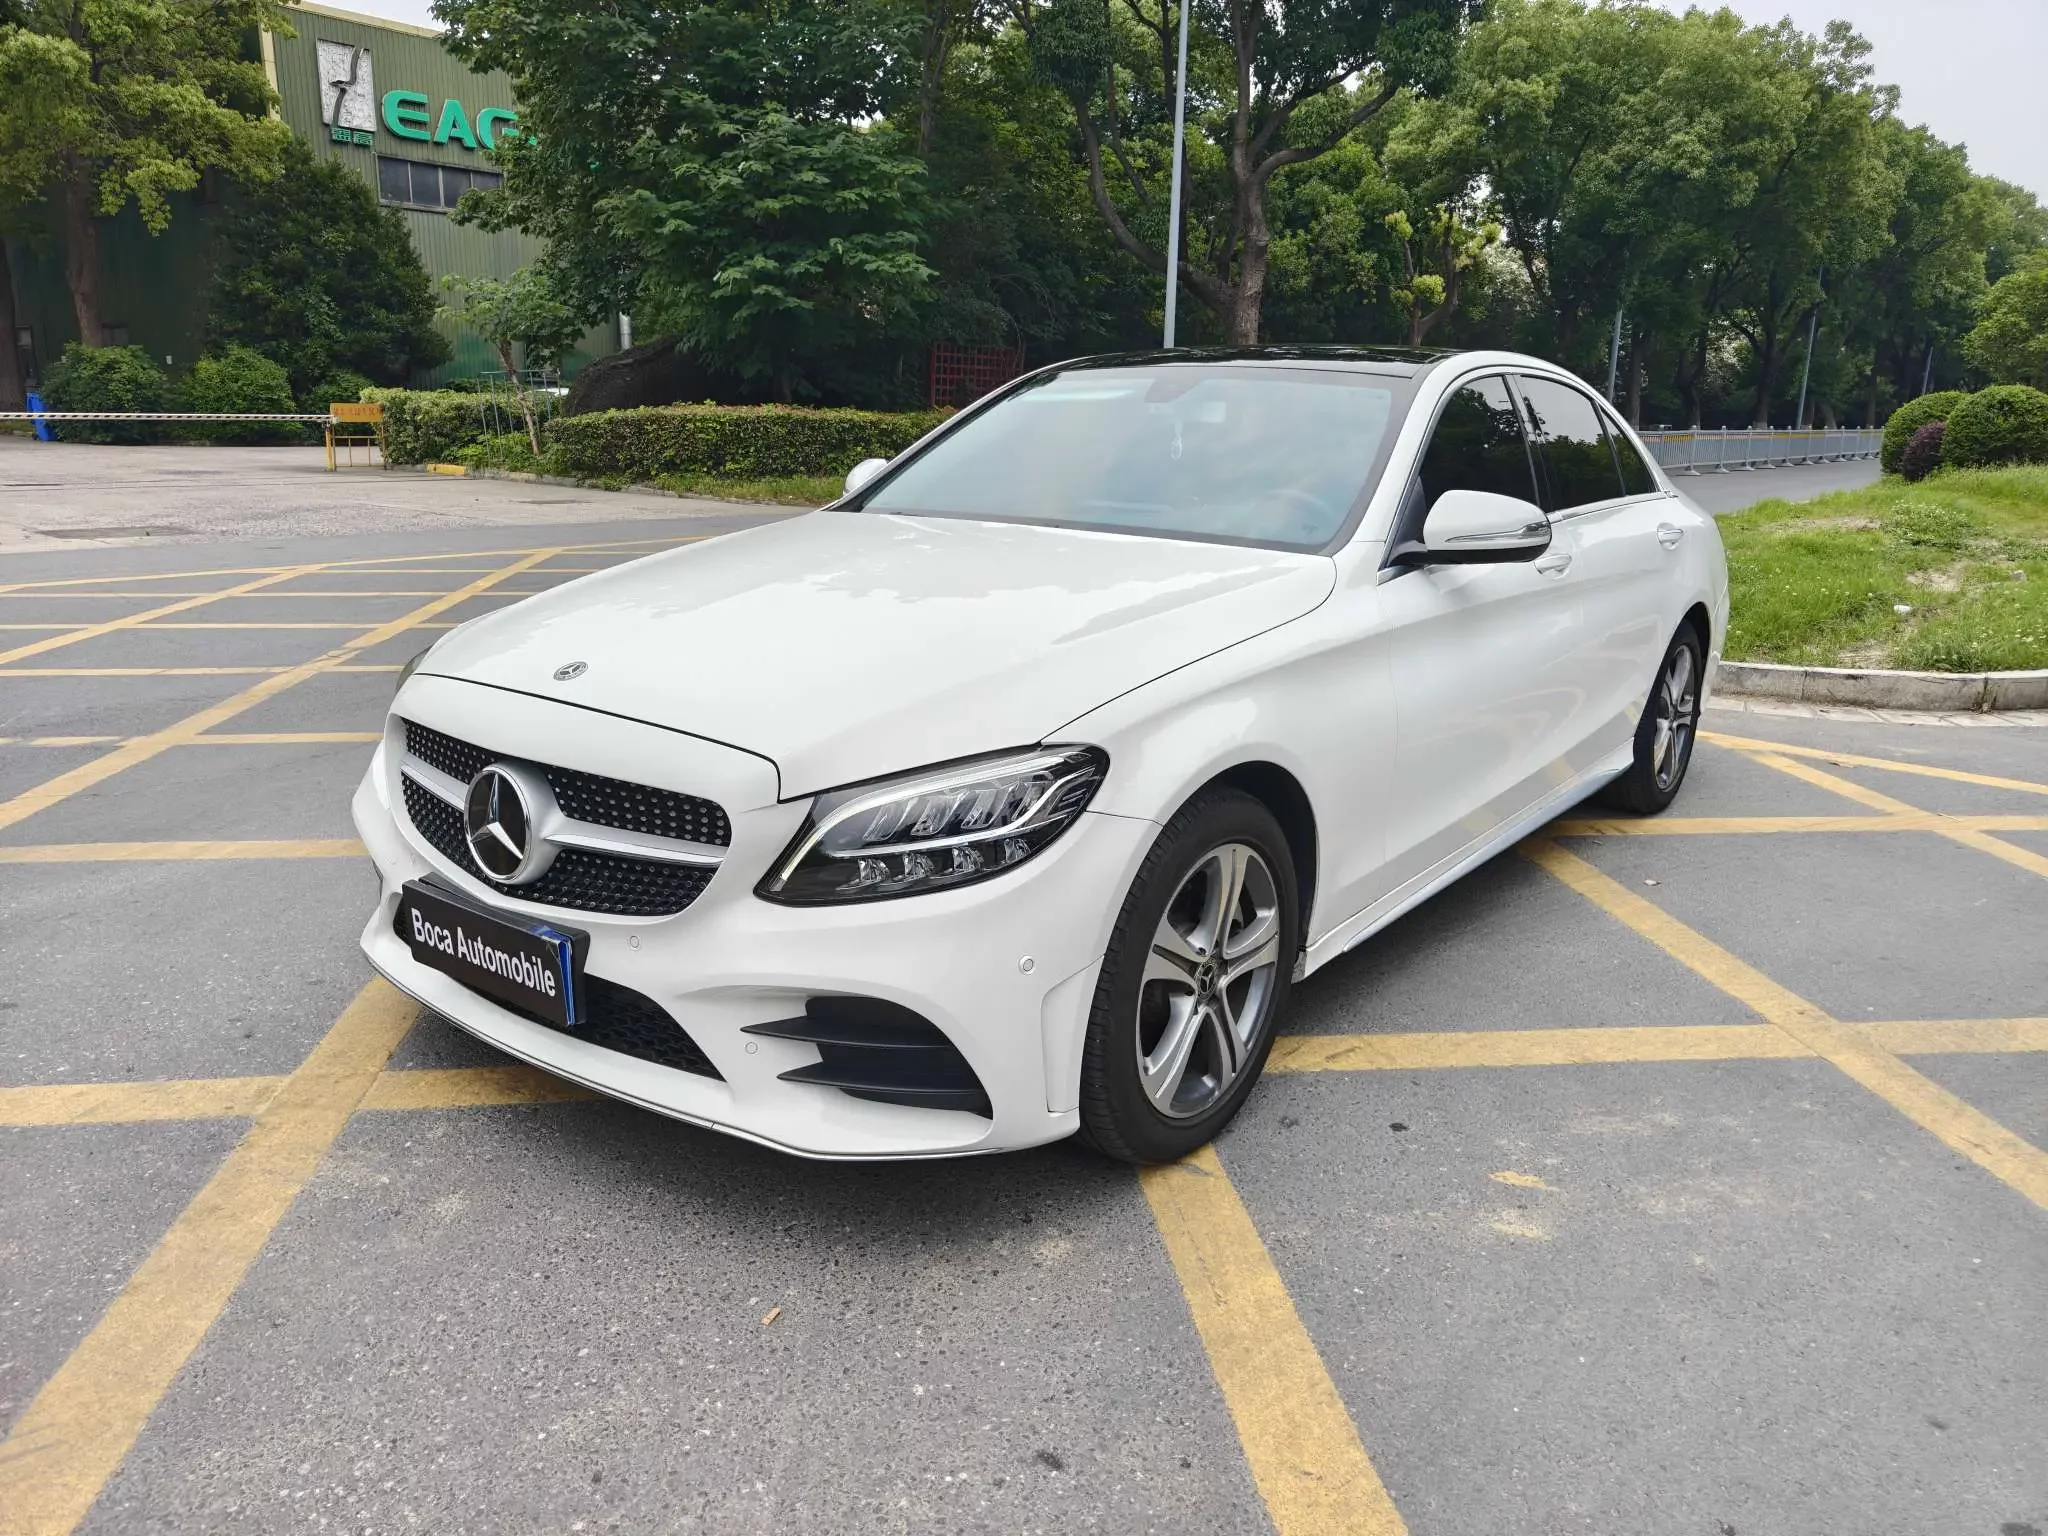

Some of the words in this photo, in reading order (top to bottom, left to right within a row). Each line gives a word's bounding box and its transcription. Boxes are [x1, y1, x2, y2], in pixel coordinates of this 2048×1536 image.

[382, 89, 537, 151] EAG
[411, 907, 454, 955] Boca
[457, 926, 556, 997] Automobile
